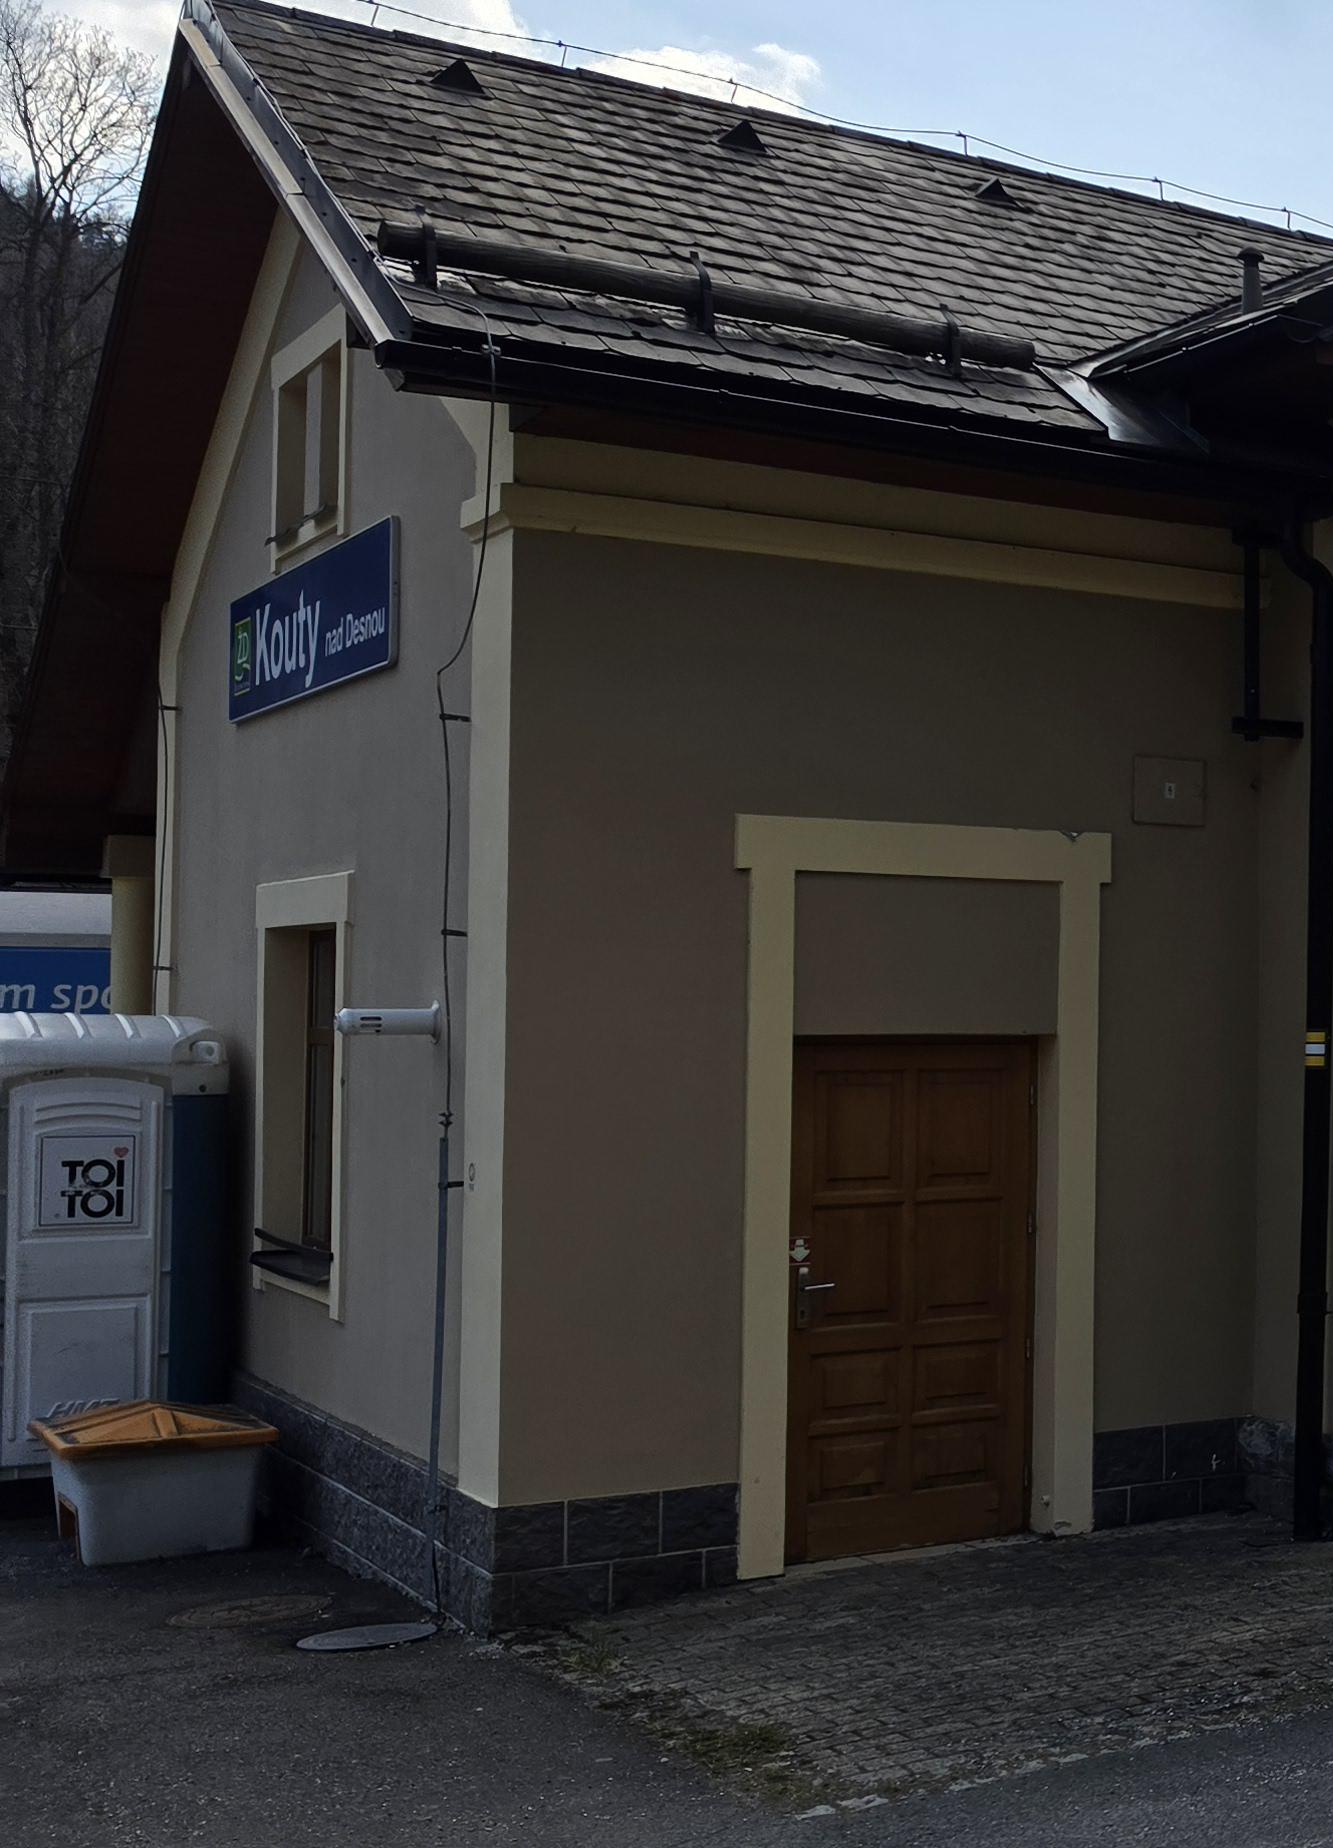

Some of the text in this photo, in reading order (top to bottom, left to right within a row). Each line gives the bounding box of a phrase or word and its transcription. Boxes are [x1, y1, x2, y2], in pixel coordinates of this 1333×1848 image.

[255, 589, 386, 689] Kouty nad Desnou
[61, 1159, 125, 1188] TOI
[60, 1189, 124, 1218] TOI
